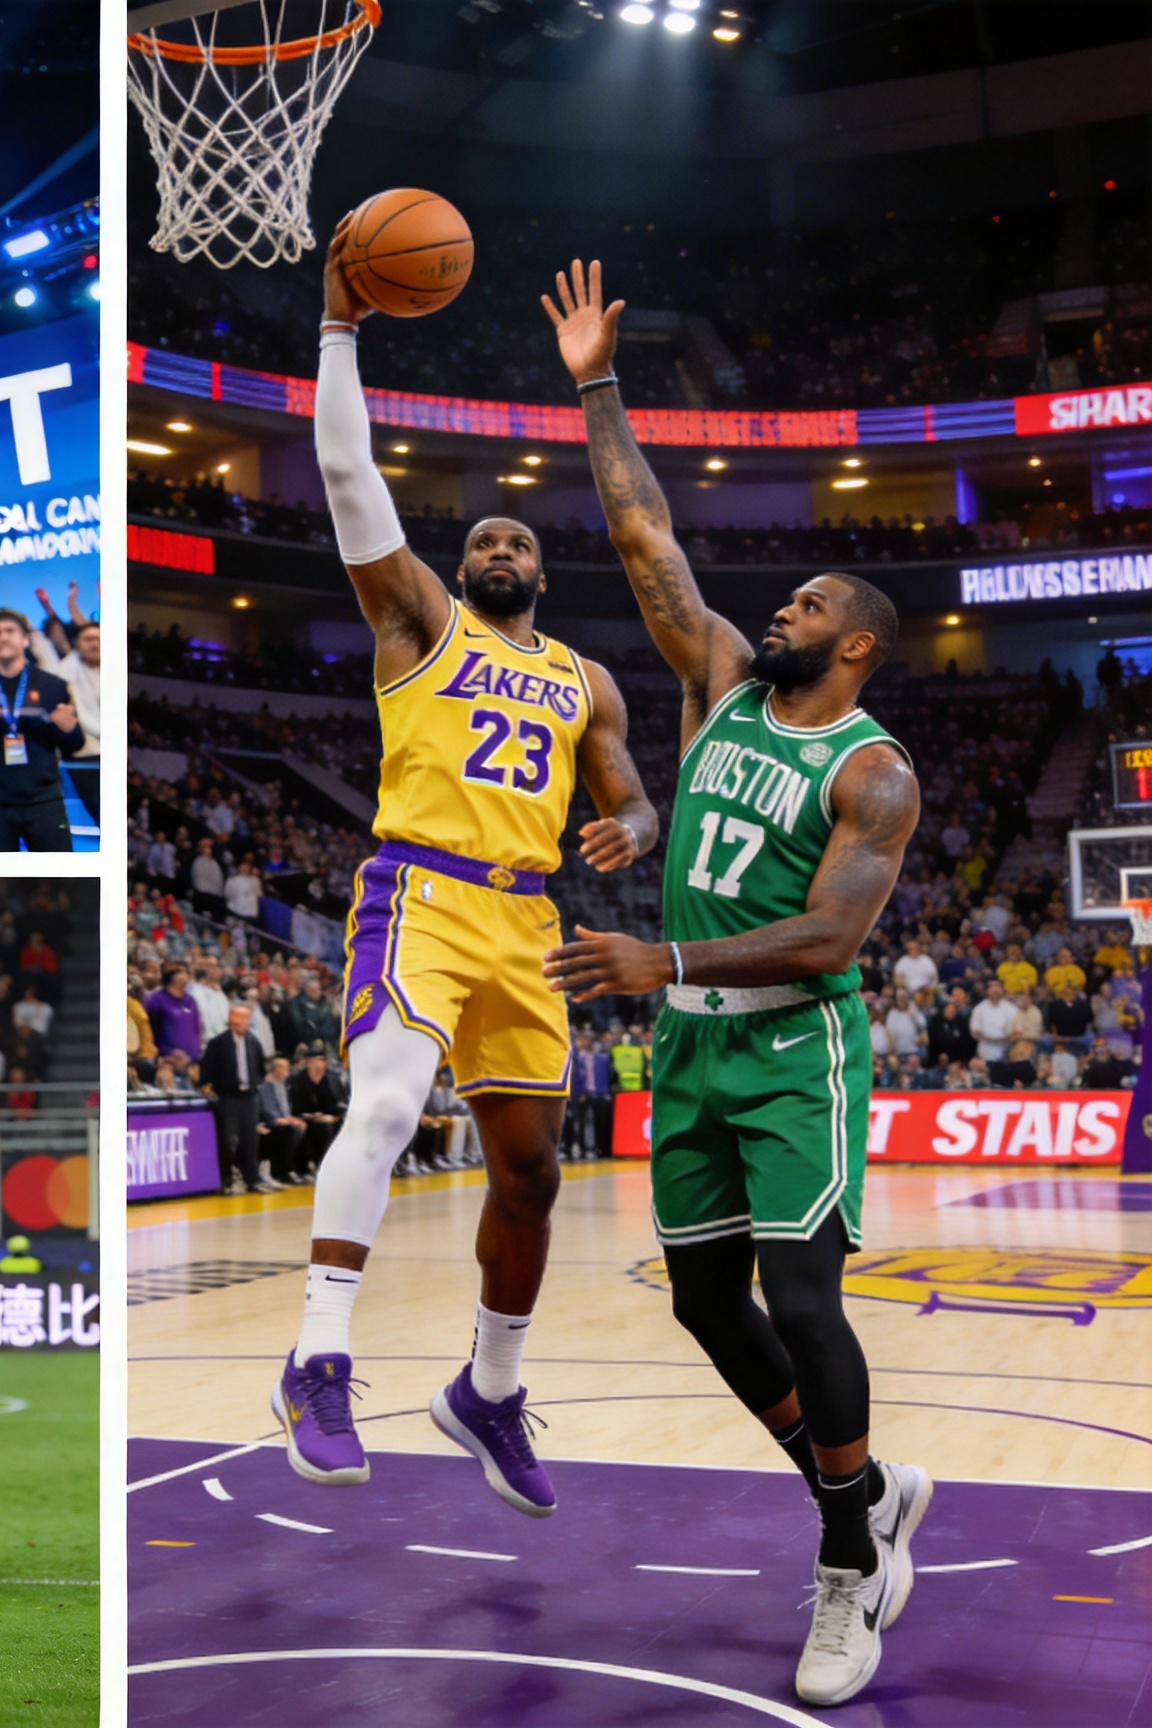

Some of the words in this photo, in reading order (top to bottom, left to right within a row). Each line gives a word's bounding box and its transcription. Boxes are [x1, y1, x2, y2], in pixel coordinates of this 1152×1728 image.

[434, 650, 579, 722] LAKERS
[461, 708, 553, 799] 23
[687, 811, 765, 898] 17
